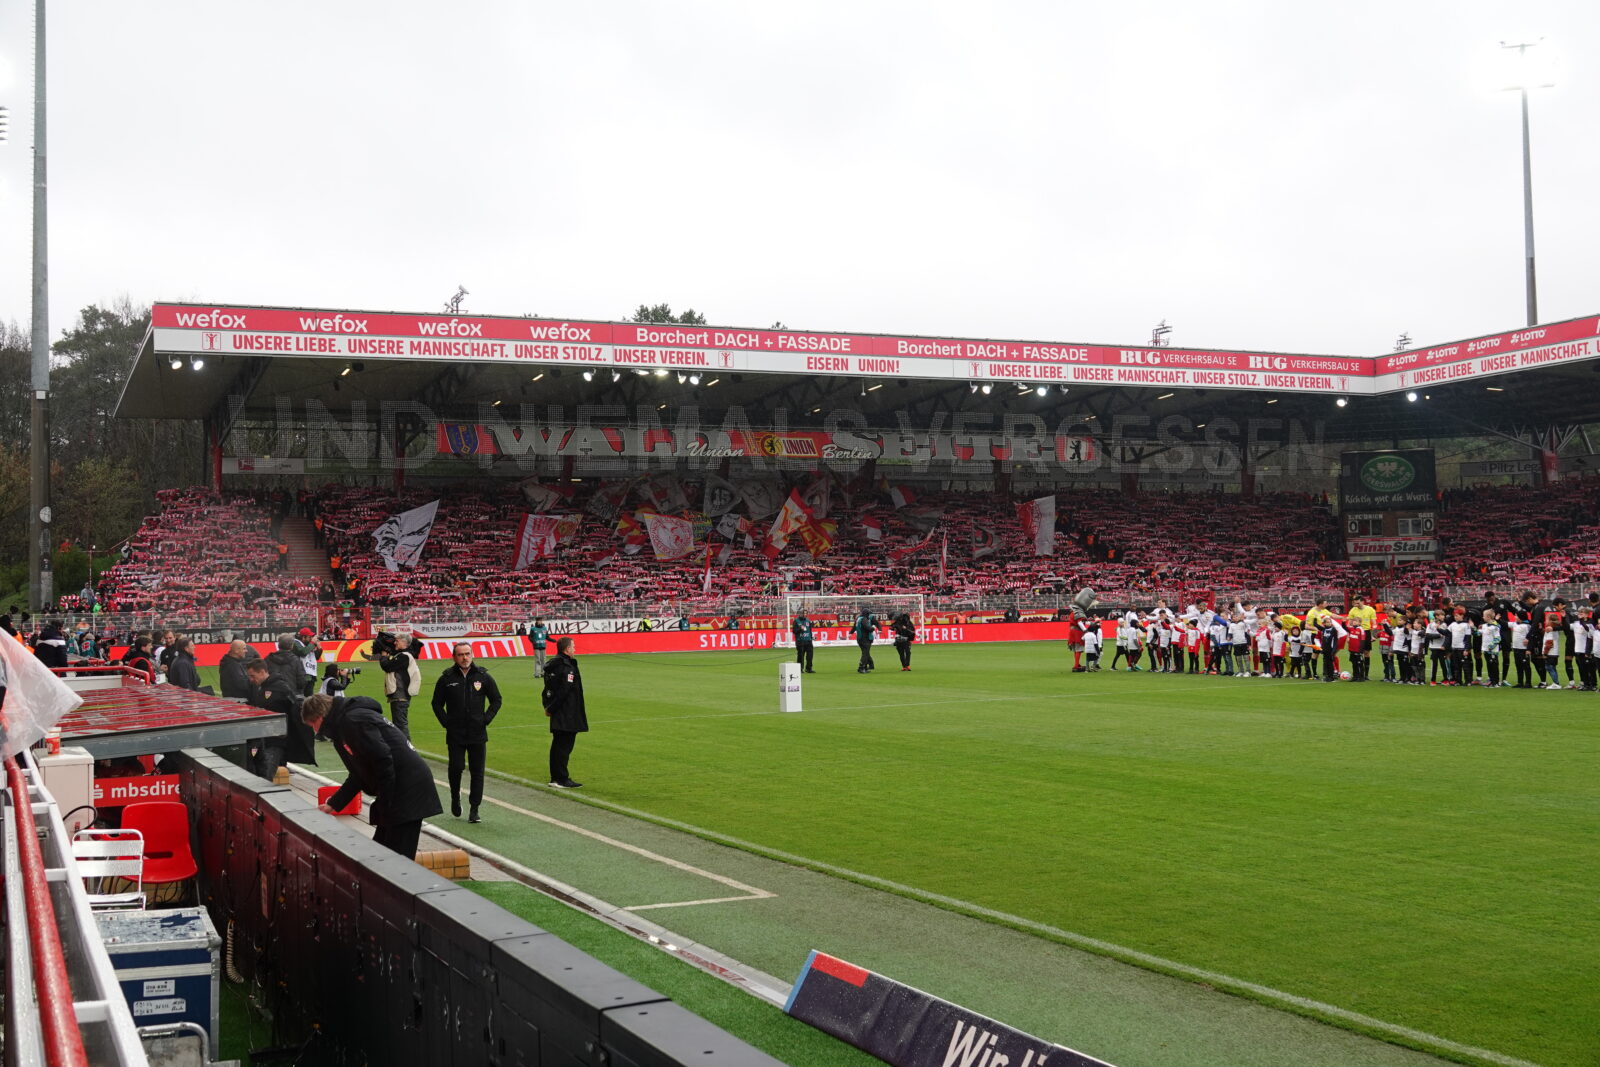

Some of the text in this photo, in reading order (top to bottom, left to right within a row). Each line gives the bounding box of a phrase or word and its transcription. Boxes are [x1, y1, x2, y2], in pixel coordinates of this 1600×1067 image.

[175, 309, 247, 329] wefox
[299, 314, 368, 333] wefox
[417, 318, 483, 337] wefox
[530, 322, 591, 341] wefox
[636, 327, 708, 346] Borchert
[714, 331, 760, 348] DACH
[778, 335, 851, 352] FASSADE
[1520, 329, 1546, 342] LOTTO
[232, 335, 710, 366] UNSERE LIEBE. UNSERE MANNSCHAFT. UNSER STOLZ. UNSER VEREIN.
[897, 340, 962, 357] Borchert
[966, 343, 1007, 358] DACH
[1023, 346, 1088, 361] FASSADE
[1434, 347, 1457, 360] LOTTO
[1476, 338, 1500, 351] LOTTO
[807, 356, 900, 373] EISERN UNION!
[1119, 350, 1237, 366] BUG VERKEHRSBAU SE
[1248, 355, 1360, 371] BUG VERKEHRSBAU SE
[1395, 354, 1417, 366] LOTTO
[1413, 366, 1448, 384] UNSERE
[1448, 363, 1476, 378] LIEBE.
[1481, 354, 1517, 373] UNSERE
[1520, 341, 1591, 366] MANNSCHAFT.
[989, 363, 1334, 389] UNSERE LIEBE. UNSERE MANNSCHAFT. UNSER STOLZ. UNSER VEREIN.
[228, 394, 1327, 477] UND NIEMALS VERGESSEN
[686, 441, 874, 460] Union Berlin
[784, 438, 817, 456] UNION
[1349, 521, 1357, 532] 0
[1424, 519, 1433, 530] 0
[700, 632, 767, 648] STADION
